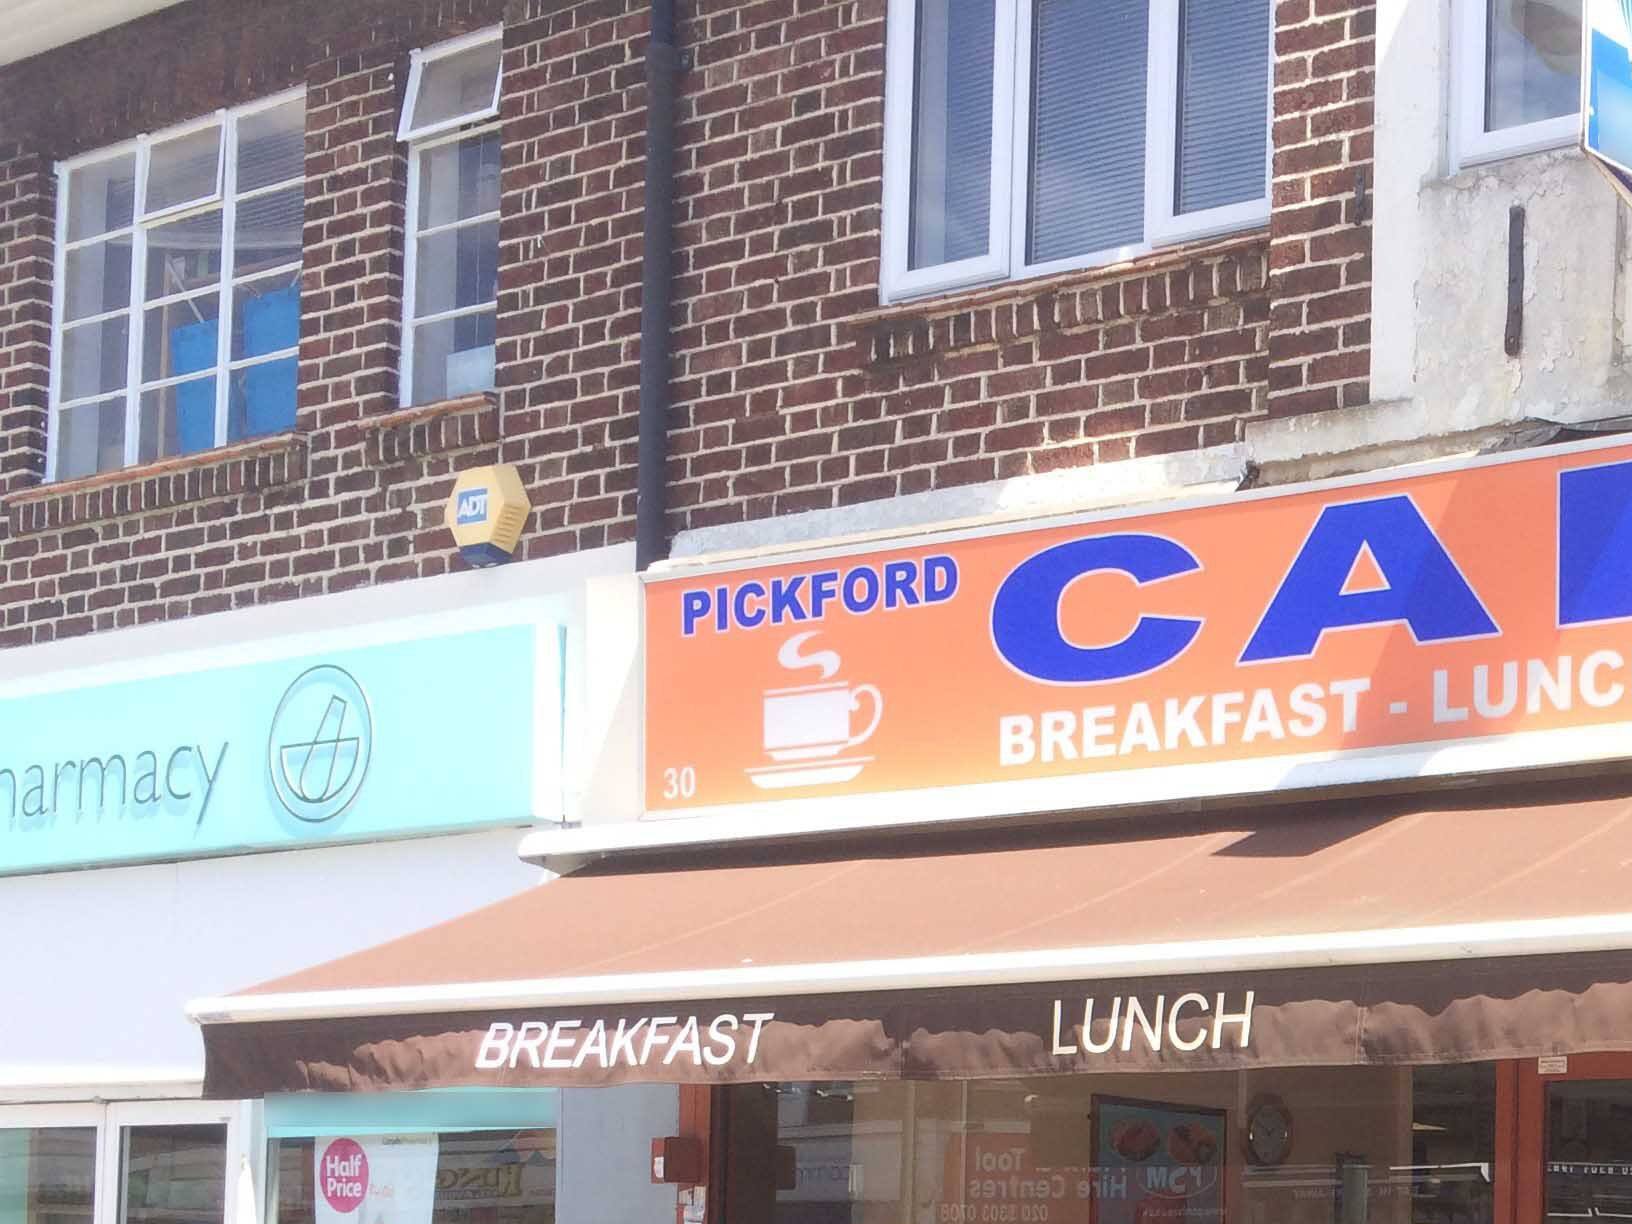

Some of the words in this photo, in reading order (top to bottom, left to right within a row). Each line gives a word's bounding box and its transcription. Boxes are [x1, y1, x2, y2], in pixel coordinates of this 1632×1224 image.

[458, 494, 489, 519] ADT
[681, 554, 960, 637] PICKFORD
[1000, 678, 1371, 767] BREAKFAST
[663, 767, 697, 800] 30
[474, 1011, 775, 1070] BREAKFAST
[1052, 990, 1255, 1056] LUNCH
[325, 1154, 362, 1177] Half
[327, 1178, 362, 1198] Price
